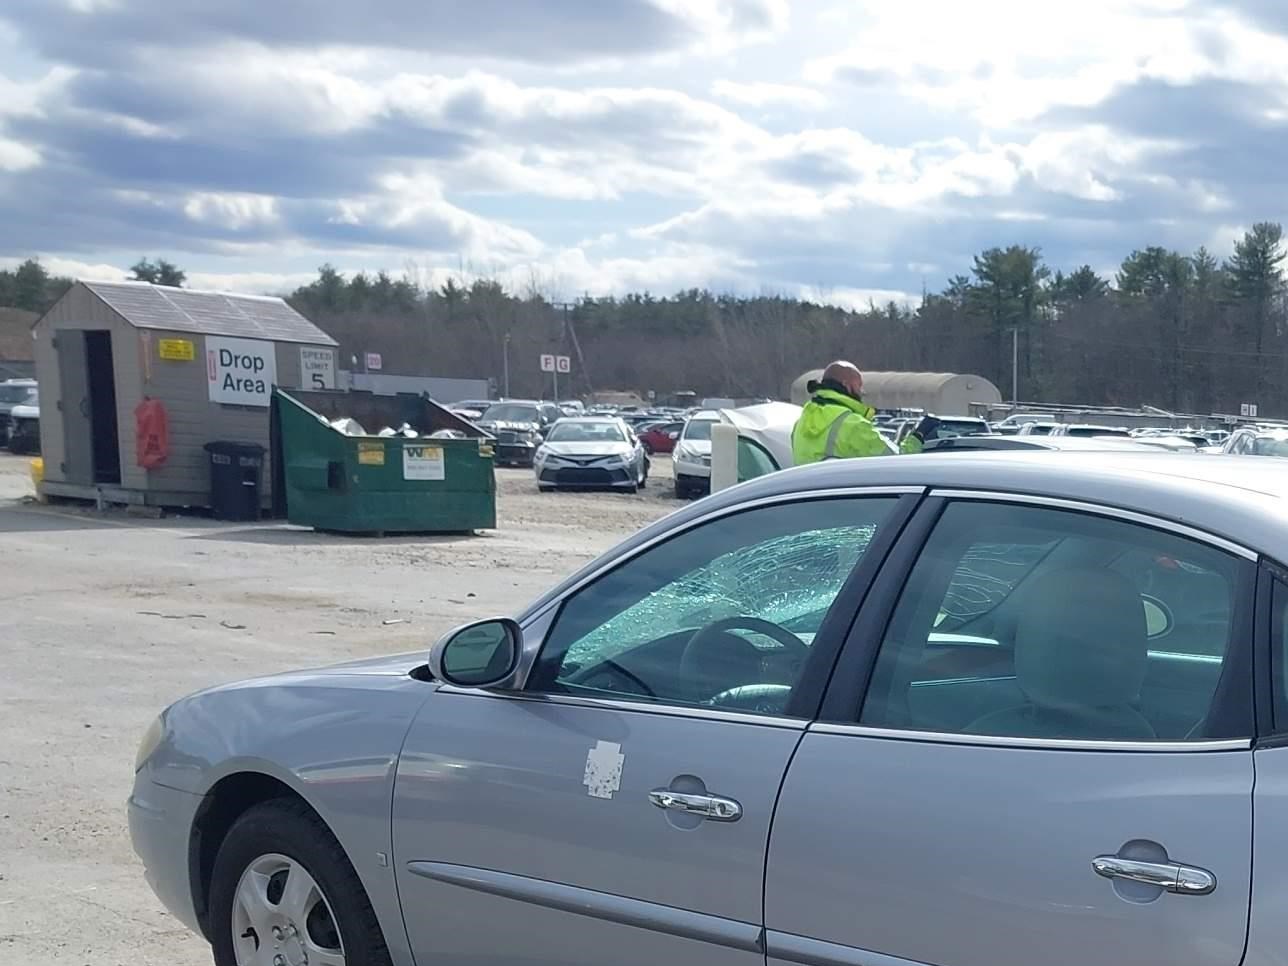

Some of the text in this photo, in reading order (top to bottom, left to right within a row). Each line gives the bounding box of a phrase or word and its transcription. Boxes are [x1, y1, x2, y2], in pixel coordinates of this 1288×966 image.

[219, 349, 264, 373] Drop
[302, 350, 332, 362] SPEED
[304, 361, 329, 371] LIMIT
[559, 358, 568, 370] G
[222, 373, 266, 393] Area
[311, 373, 326, 390] 5
